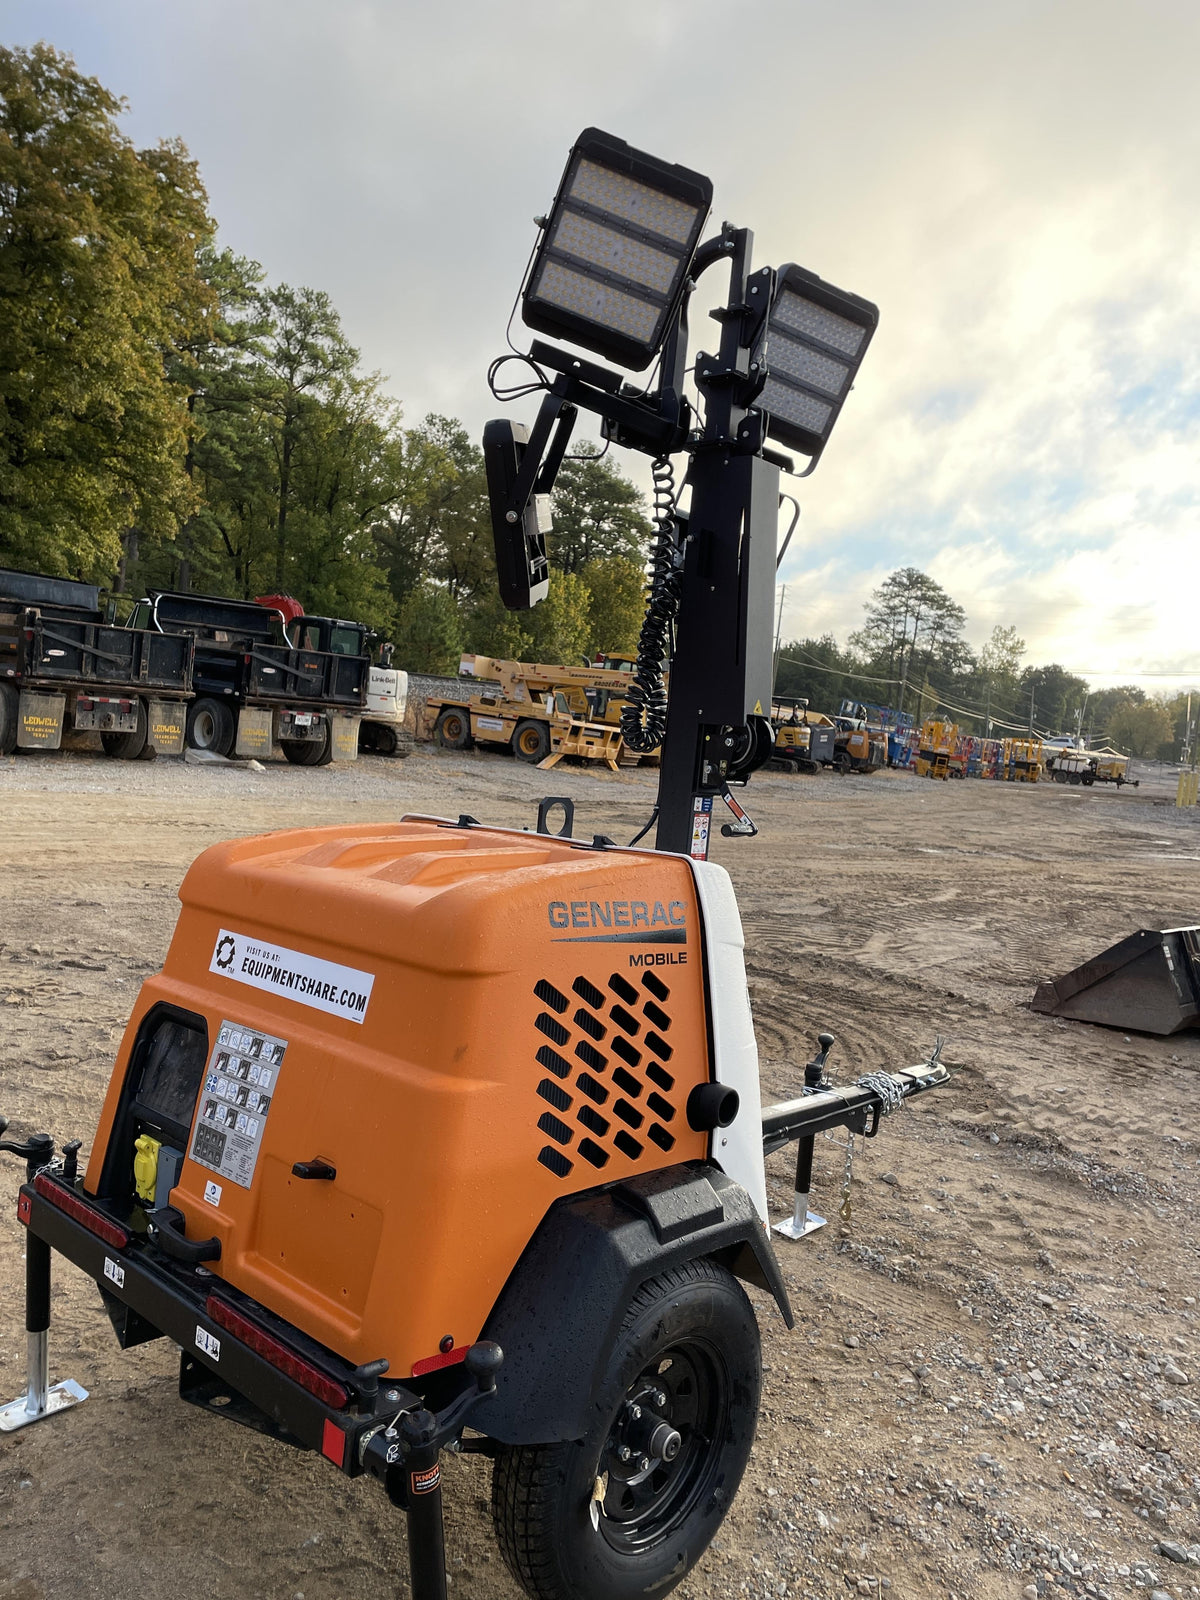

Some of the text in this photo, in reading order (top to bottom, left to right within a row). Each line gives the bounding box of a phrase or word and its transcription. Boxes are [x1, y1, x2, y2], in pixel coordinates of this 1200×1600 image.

[23, 716, 58, 727] LEDWELL
[152, 724, 181, 734] LEDWELL
[547, 901, 686, 929] GENERAC
[246, 946, 281, 962] VISIT US AT:
[629, 952, 687, 967] MOBILE
[227, 966, 235, 975] TM
[241, 957, 367, 1012] EQUIPMENTSHARE.COM
